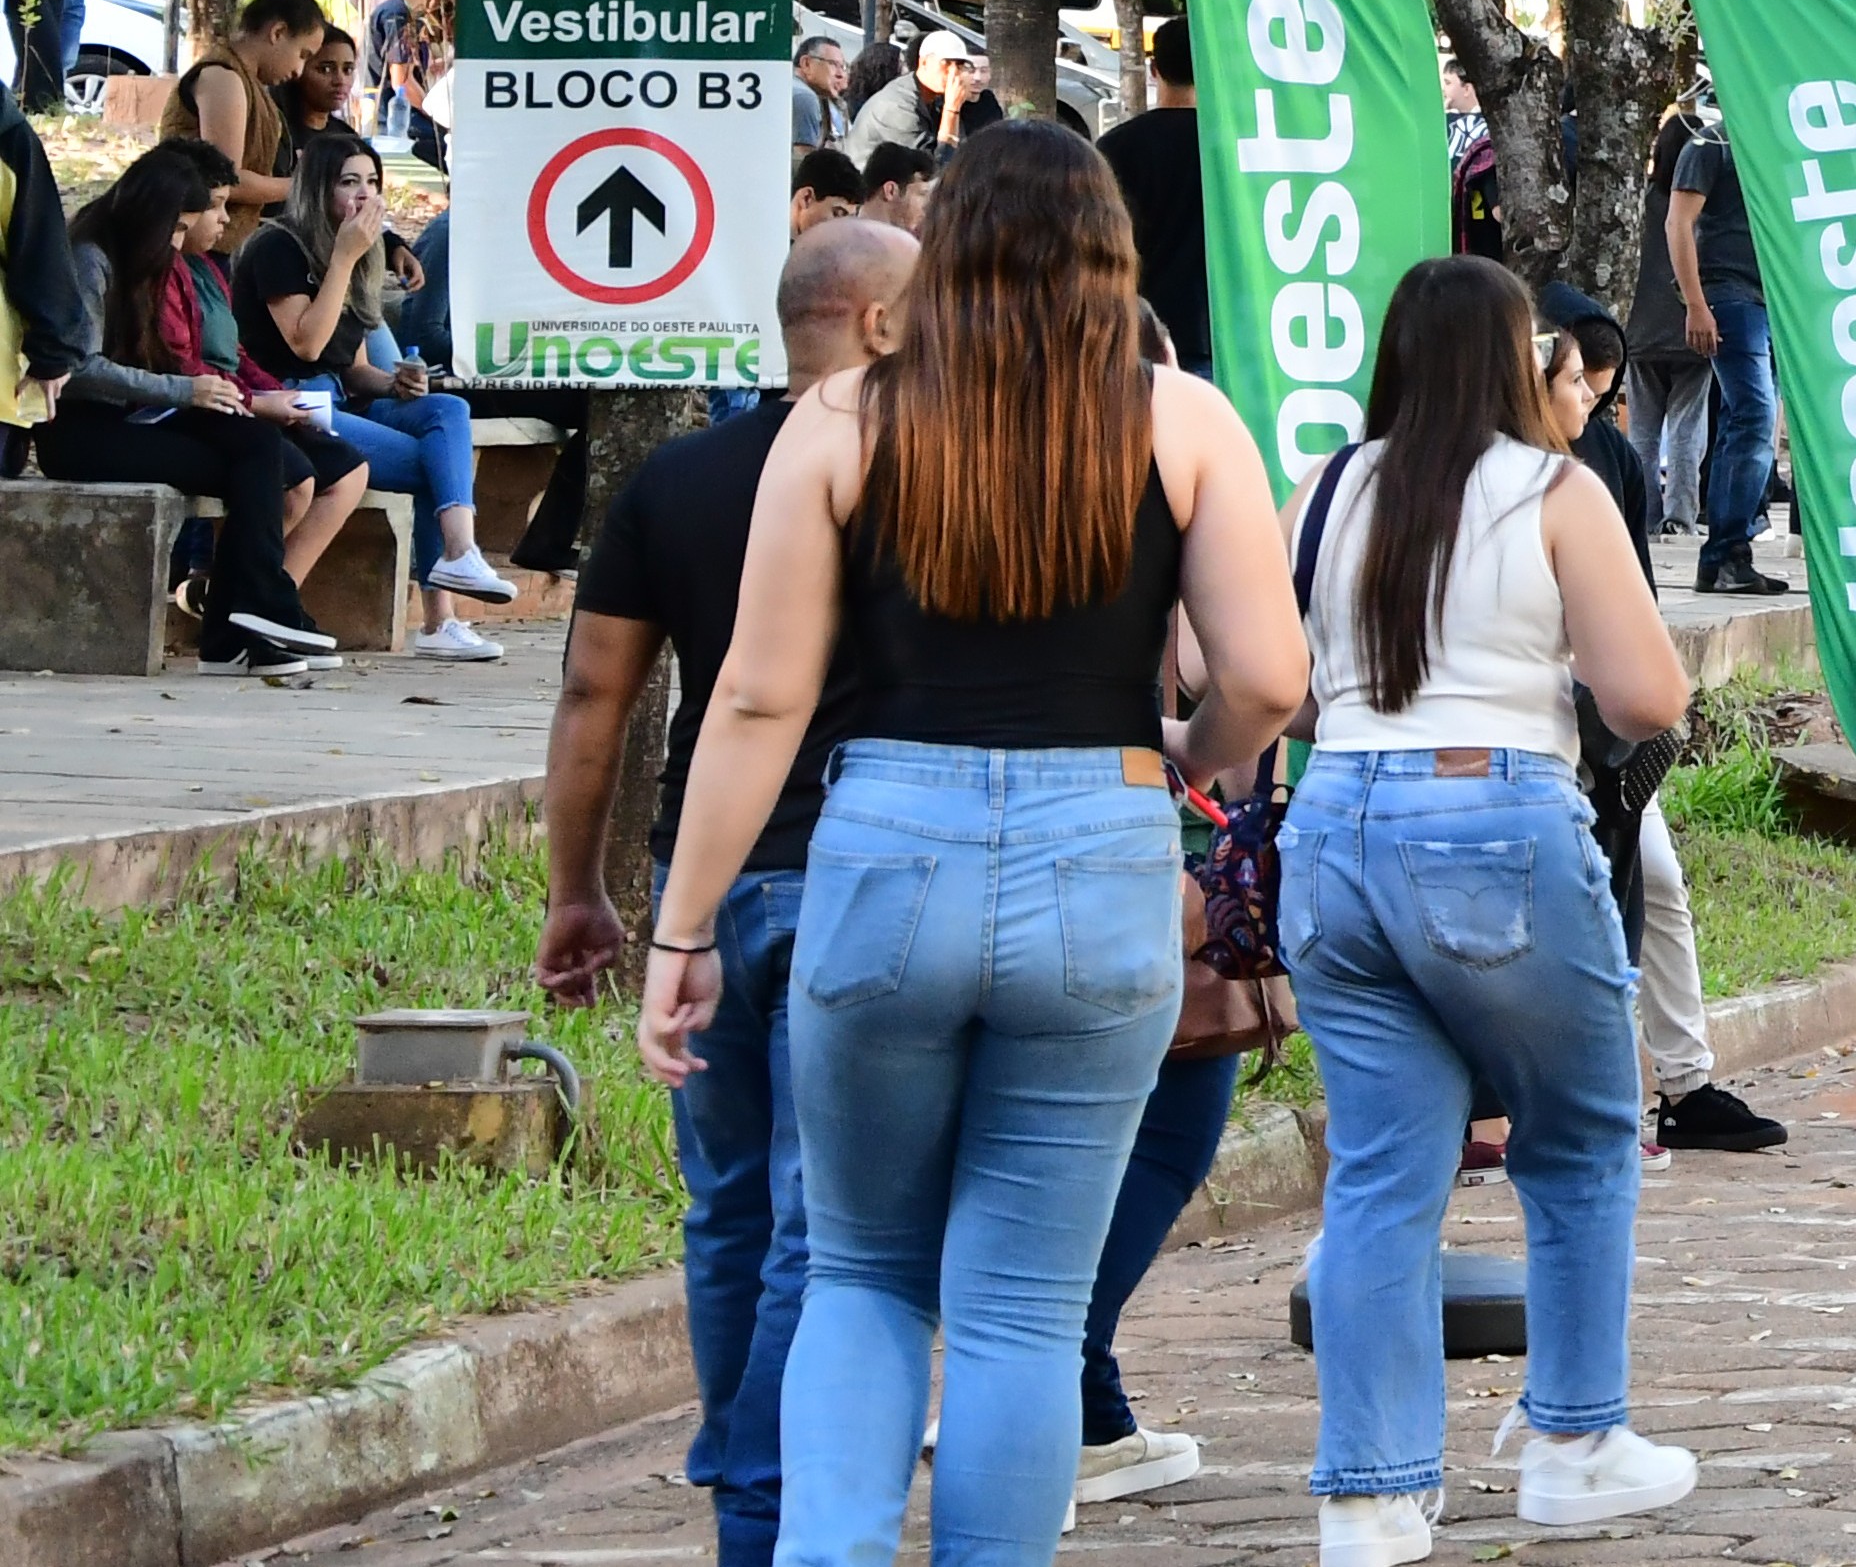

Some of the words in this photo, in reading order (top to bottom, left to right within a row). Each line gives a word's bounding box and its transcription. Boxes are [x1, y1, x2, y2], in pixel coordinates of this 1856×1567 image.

[483, 0, 767, 43] Vestibular
[485, 69, 679, 110] BLOCO
[698, 71, 763, 110] B3
[532, 321, 627, 332] UNIVERSIDADE
[631, 321, 649, 332] DO
[653, 321, 695, 332] OESTE
[700, 322, 760, 333] PAULISTA
